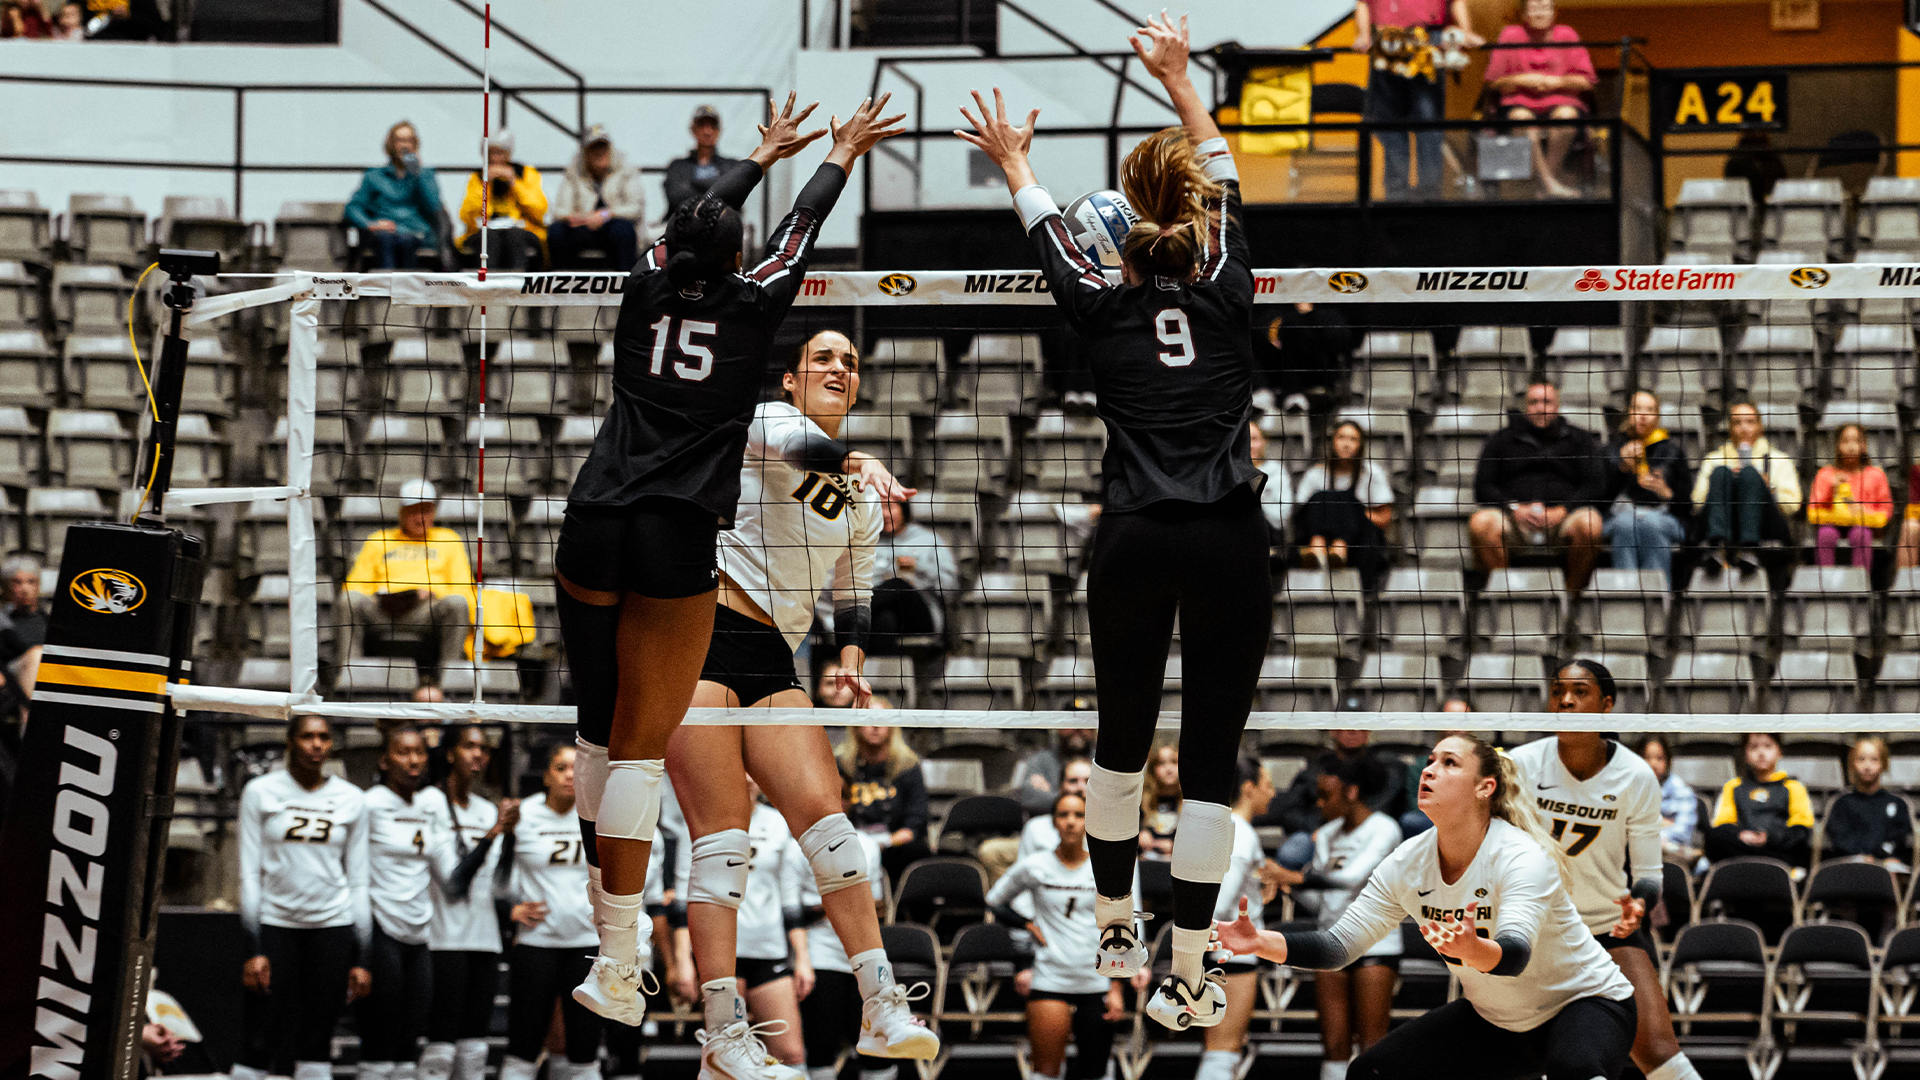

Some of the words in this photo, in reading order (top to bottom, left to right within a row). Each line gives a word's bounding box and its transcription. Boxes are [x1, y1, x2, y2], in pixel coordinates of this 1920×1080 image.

[1716, 80, 1777, 124] 24
[1112, 197, 1140, 226] molt
[520, 275, 627, 294] MIZZOU
[963, 274, 1050, 293] MIZZO
[1415, 271, 1528, 291] MIZZOU
[650, 315, 718, 382] 15
[1155, 307, 1197, 368] 9
[790, 472, 847, 522] 10
[1536, 796, 1618, 820] MISSOURI
[283, 816, 334, 844] 23
[412, 829, 425, 856] 4
[1550, 817, 1602, 857] 17
[548, 839, 582, 865] 21
[29, 724, 119, 1080] MIZZOU
[1421, 904, 1492, 922] MISSORI
